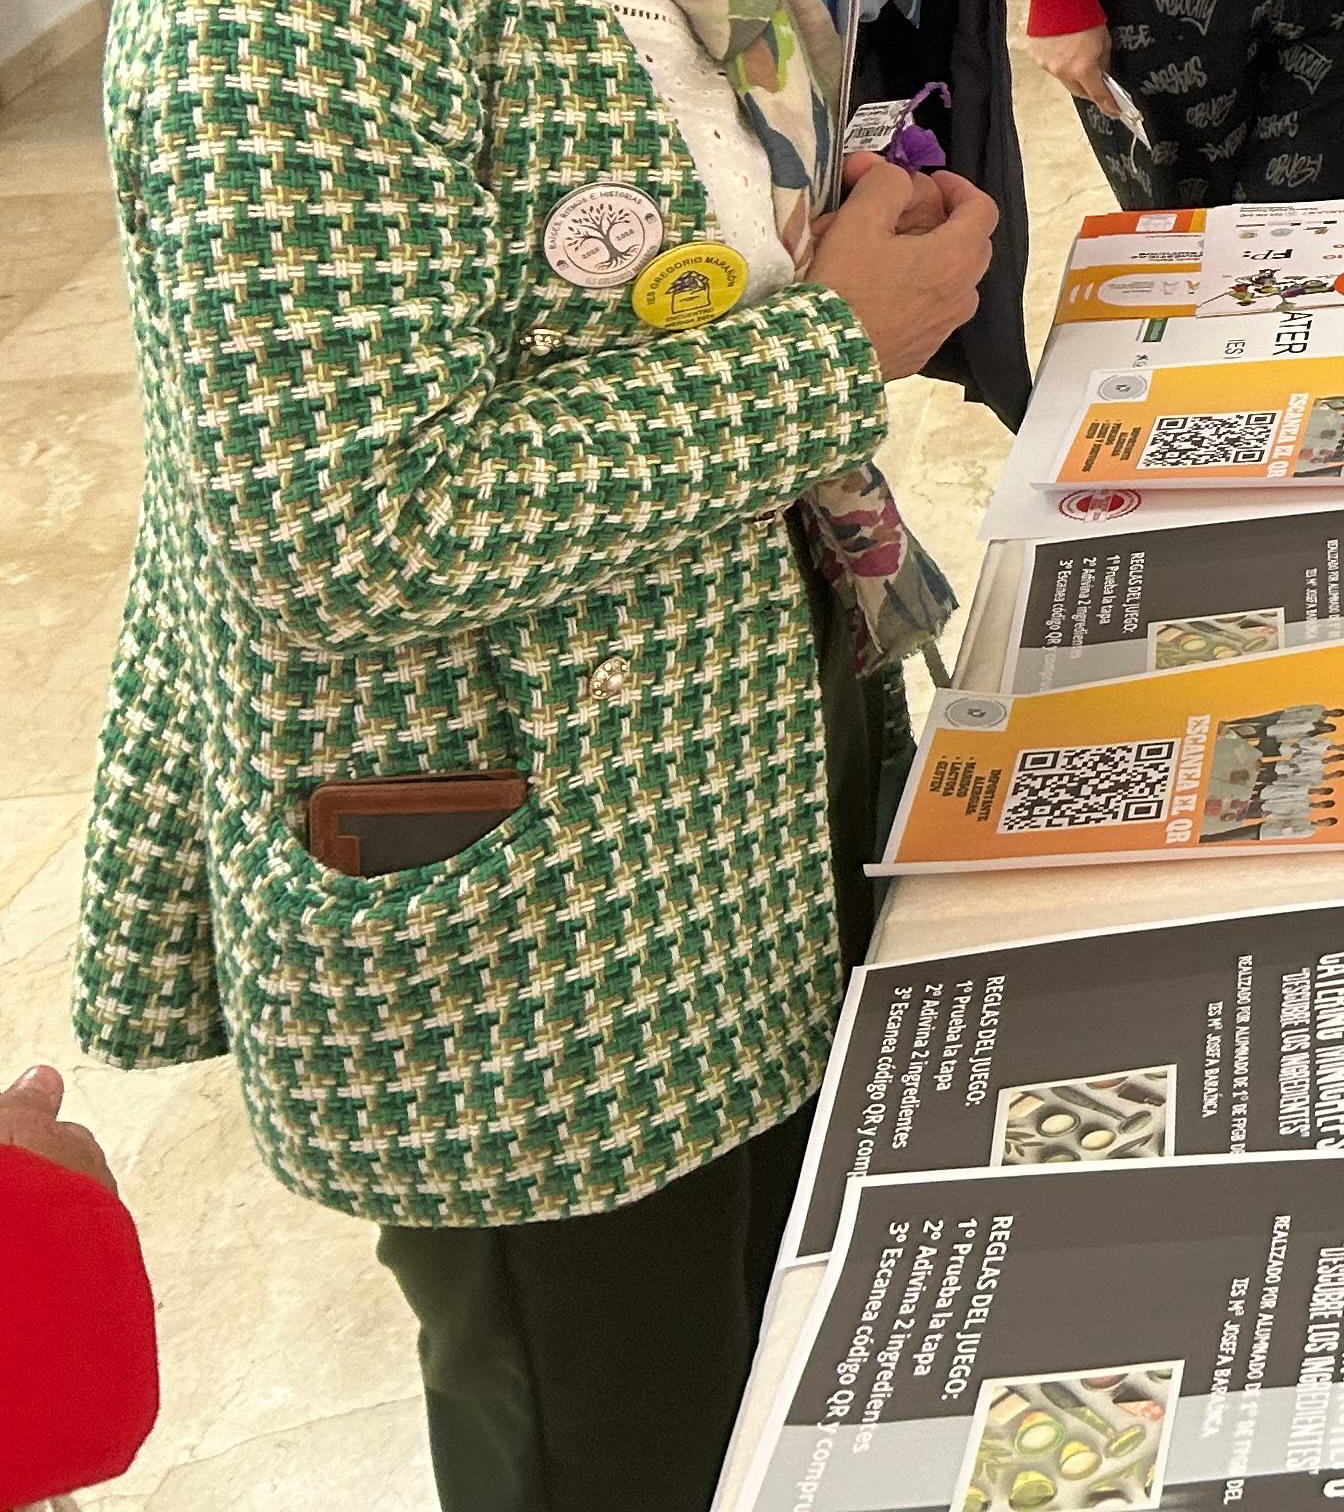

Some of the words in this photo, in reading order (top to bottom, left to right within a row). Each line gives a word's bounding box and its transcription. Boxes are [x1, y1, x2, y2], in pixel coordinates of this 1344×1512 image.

[653, 256, 703, 289] GREGORIO
[1274, 392, 1309, 443] ESCANEA
[1266, 460, 1290, 478] QR
[1078, 568, 1096, 599] Adivina
[1102, 565, 1120, 596] Prueba
[1128, 551, 1145, 586] REGLAS
[1054, 570, 1072, 602] Escanea
[1101, 595, 1117, 605] la
[1126, 586, 1142, 603] DEL
[1045, 603, 1067, 631] código
[1096, 604, 1114, 625] tapa
[1122, 603, 1140, 634] JUEGO:
[1045, 632, 1063, 645] QR
[1176, 714, 1211, 792] ESCANEA
[929, 761, 948, 793] GLUTEN
[942, 761, 962, 797] LACTOSA
[977, 769, 1002, 822] IMPORTANTE
[1172, 794, 1197, 815] EL
[1166, 818, 1193, 844] QR
[1236, 954, 1253, 1005] REALIZADO
[979, 975, 1006, 1028] REGLAS
[1207, 1001, 1223, 1017] IES
[1235, 1005, 1251, 1024] POR
[880, 1001, 909, 1054] Escanea
[913, 999, 940, 1048] Adivina
[945, 995, 971, 1043] Prueba
[911, 1050, 930, 1060] 2
[943, 1043, 963, 1058] la
[974, 1028, 997, 1056] DEL
[1205, 1033, 1221, 1066] JOSEFA
[1233, 1026, 1250, 1076] ALUMNADO
[1280, 1027, 1311, 1052] LOS
[866, 1055, 896, 1101] código
[933, 1059, 958, 1092] tapa
[964, 1056, 992, 1108] JUEGO:
[1232, 1076, 1248, 1089] DE
[862, 1103, 886, 1125] QR
[891, 1060, 929, 1150] ingredientes
[1231, 1103, 1247, 1117] DE
[857, 1125, 877, 1136] y
[889, 1221, 910, 1243] 3º
[923, 1219, 944, 1241] 2º
[957, 1218, 978, 1239] 1º
[976, 1215, 1013, 1291] REGLAS
[1264, 1214, 1292, 1284] REALIZADO
[861, 1247, 903, 1322] Escanea
[899, 1244, 938, 1315] Adivina
[936, 1242, 973, 1310] Prueba
[1230, 1276, 1250, 1298] IES
[963, 1293, 994, 1330] DEL
[1259, 1285, 1280, 1309] POR
[893, 1318, 916, 1332] 2
[929, 1311, 954, 1330] la
[1215, 1320, 1240, 1367] JOSEFA
[1246, 1312, 1274, 1381] ALUMNADO
[1304, 1322, 1341, 1353] LOS
[836, 1324, 875, 1386] código
[912, 1332, 944, 1377] tapa
[940, 1331, 982, 1401] JUEGO:
[826, 1389, 854, 1418] QR
[853, 1332, 912, 1455] ingredientes
[816, 1420, 840, 1435] y
[1223, 1478, 1245, 1505] DEL
